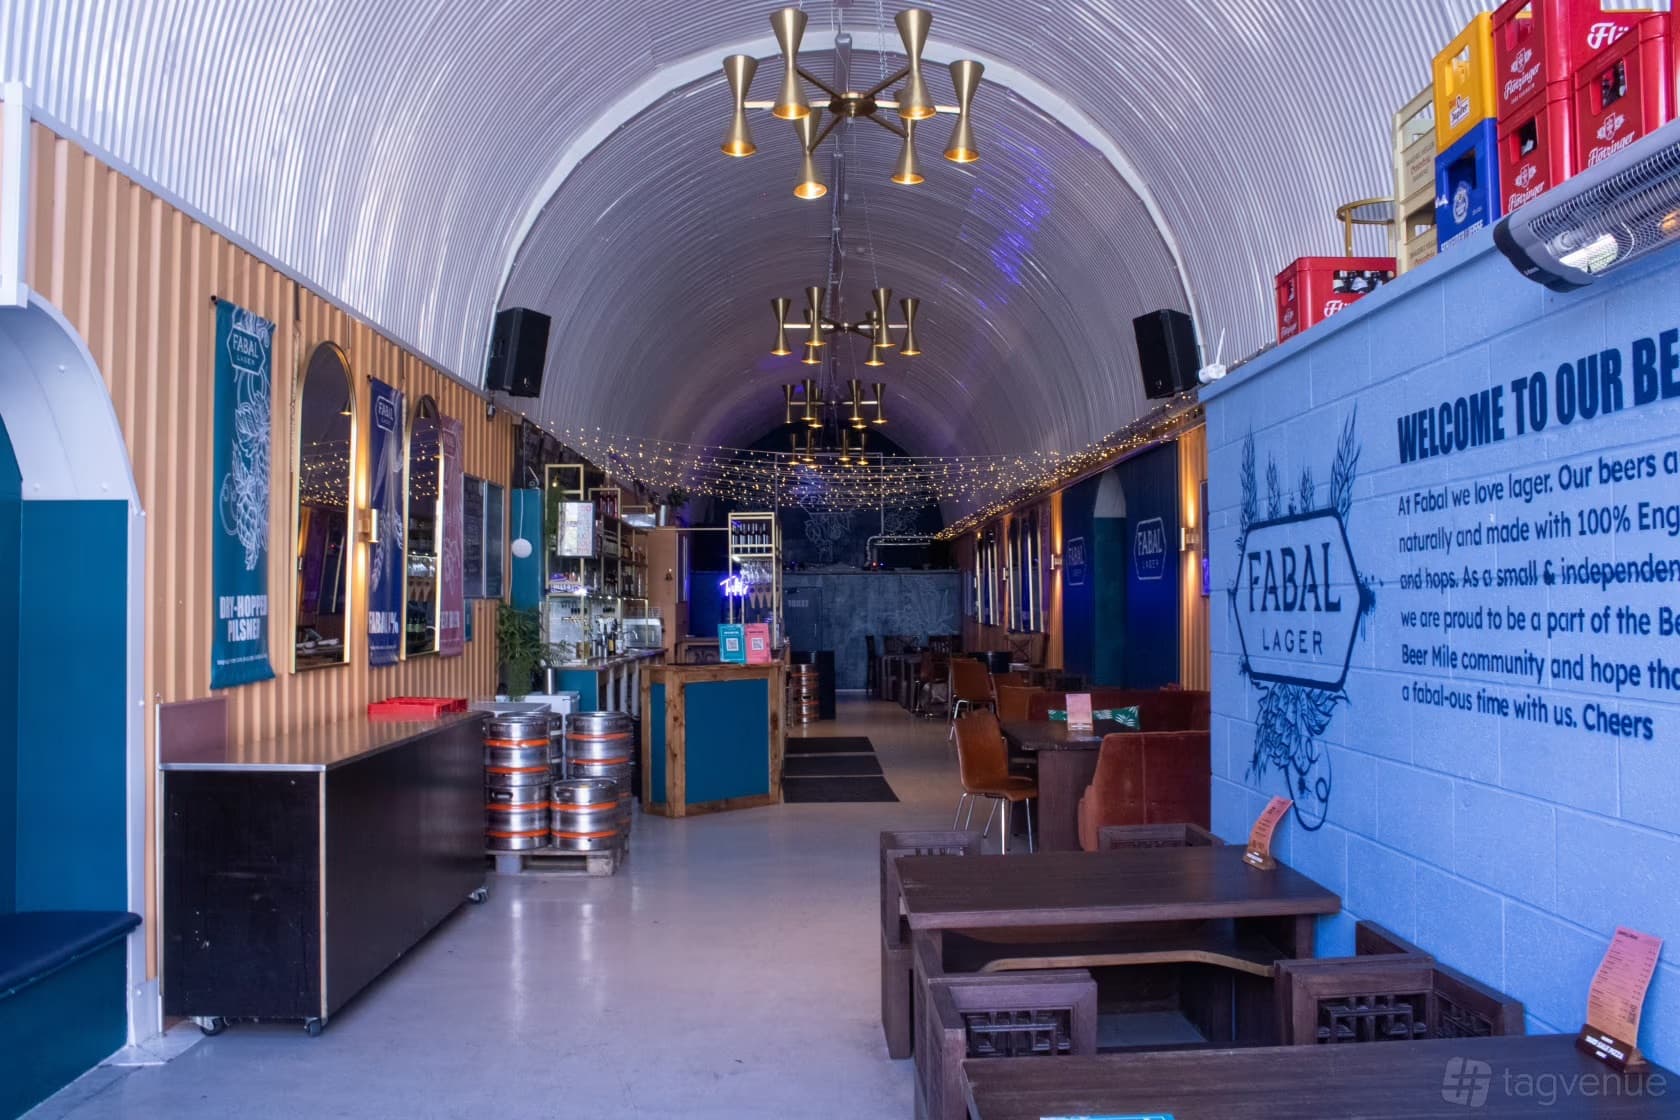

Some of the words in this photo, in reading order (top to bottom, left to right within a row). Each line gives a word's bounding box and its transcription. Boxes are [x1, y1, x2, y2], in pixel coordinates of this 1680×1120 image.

[232, 334, 259, 359] FABAL
[1397, 384, 1505, 464] WELCOME
[1511, 371, 1547, 436] TO
[1556, 348, 1623, 426] OUR
[1632, 328, 1680, 406] BE
[1398, 495, 1410, 516] At
[1414, 486, 1448, 514] Fabal
[1452, 488, 1470, 507] we
[1474, 481, 1504, 505] love
[1508, 472, 1553, 503] lager.
[1558, 464, 1593, 491] Our
[1598, 456, 1657, 484] beers
[1138, 528, 1162, 556] FABAL
[1399, 526, 1452, 555] naturally
[1456, 521, 1482, 547] and
[1486, 516, 1530, 544] made
[1534, 511, 1571, 540] with
[1578, 504, 1631, 536] 100%
[1637, 501, 1680, 537] Eng
[1247, 542, 1342, 613] FABAL
[1400, 568, 1422, 590] and
[1425, 567, 1459, 595] hops.
[1462, 565, 1479, 588] As
[1482, 568, 1492, 587] a
[1496, 559, 1538, 588] small
[1543, 559, 1556, 586] &
[1261, 627, 1323, 656] LAGER
[1401, 610, 1417, 628] we
[1419, 610, 1441, 628] are
[1443, 605, 1483, 635] proud
[1487, 607, 1502, 630] to
[1506, 604, 1526, 631] be
[1530, 611, 1541, 631] a
[1546, 607, 1585, 639] part
[1591, 604, 1611, 634] of
[1616, 604, 1651, 635] the
[1401, 643, 1428, 666] Beer
[1431, 643, 1458, 670] Mile
[1461, 648, 1544, 685] community
[1551, 653, 1584, 681] and
[1590, 653, 1641, 693] hope
[1402, 684, 1410, 701] a
[1412, 680, 1473, 712] fabal-ous
[1476, 687, 1510, 717] time
[1513, 692, 1548, 724] with
[1553, 704, 1578, 729] us.
[1582, 702, 1655, 741] Cheers
